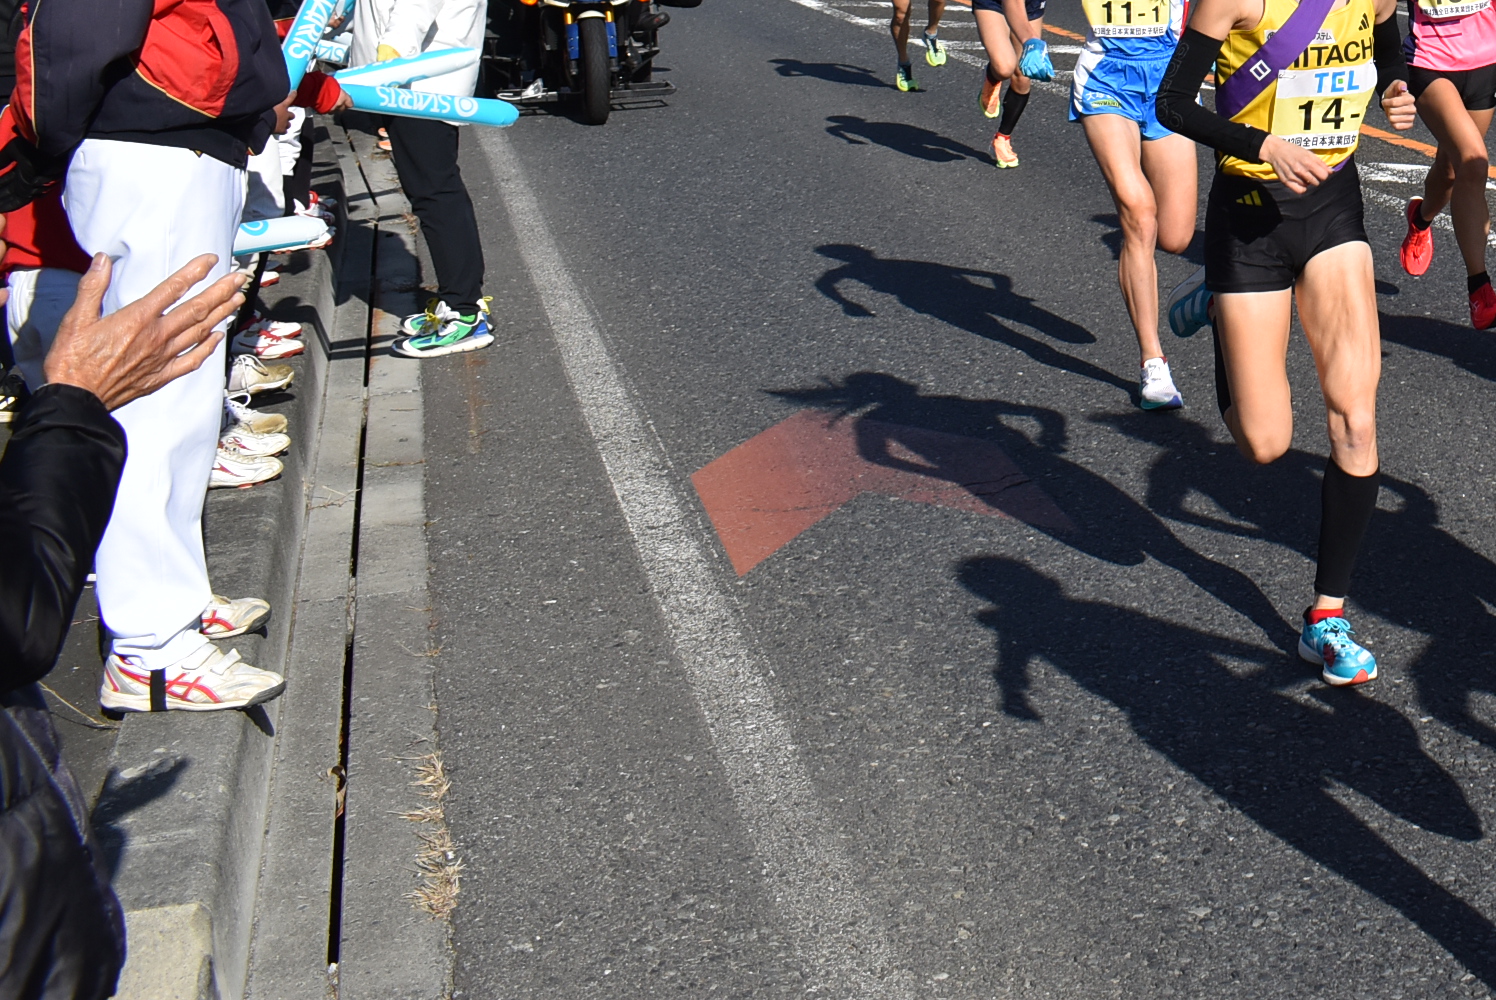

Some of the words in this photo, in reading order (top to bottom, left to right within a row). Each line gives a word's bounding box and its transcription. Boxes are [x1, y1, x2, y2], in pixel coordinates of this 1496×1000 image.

[1101, 0, 1166, 24] 11-1
[1315, 31, 1333, 41] ステム
[1293, 35, 1374, 69] ITACH
[1314, 70, 1360, 94] TEL
[376, 86, 453, 116] STARTS
[1283, 134, 1357, 149] 43回全日本実業団女
